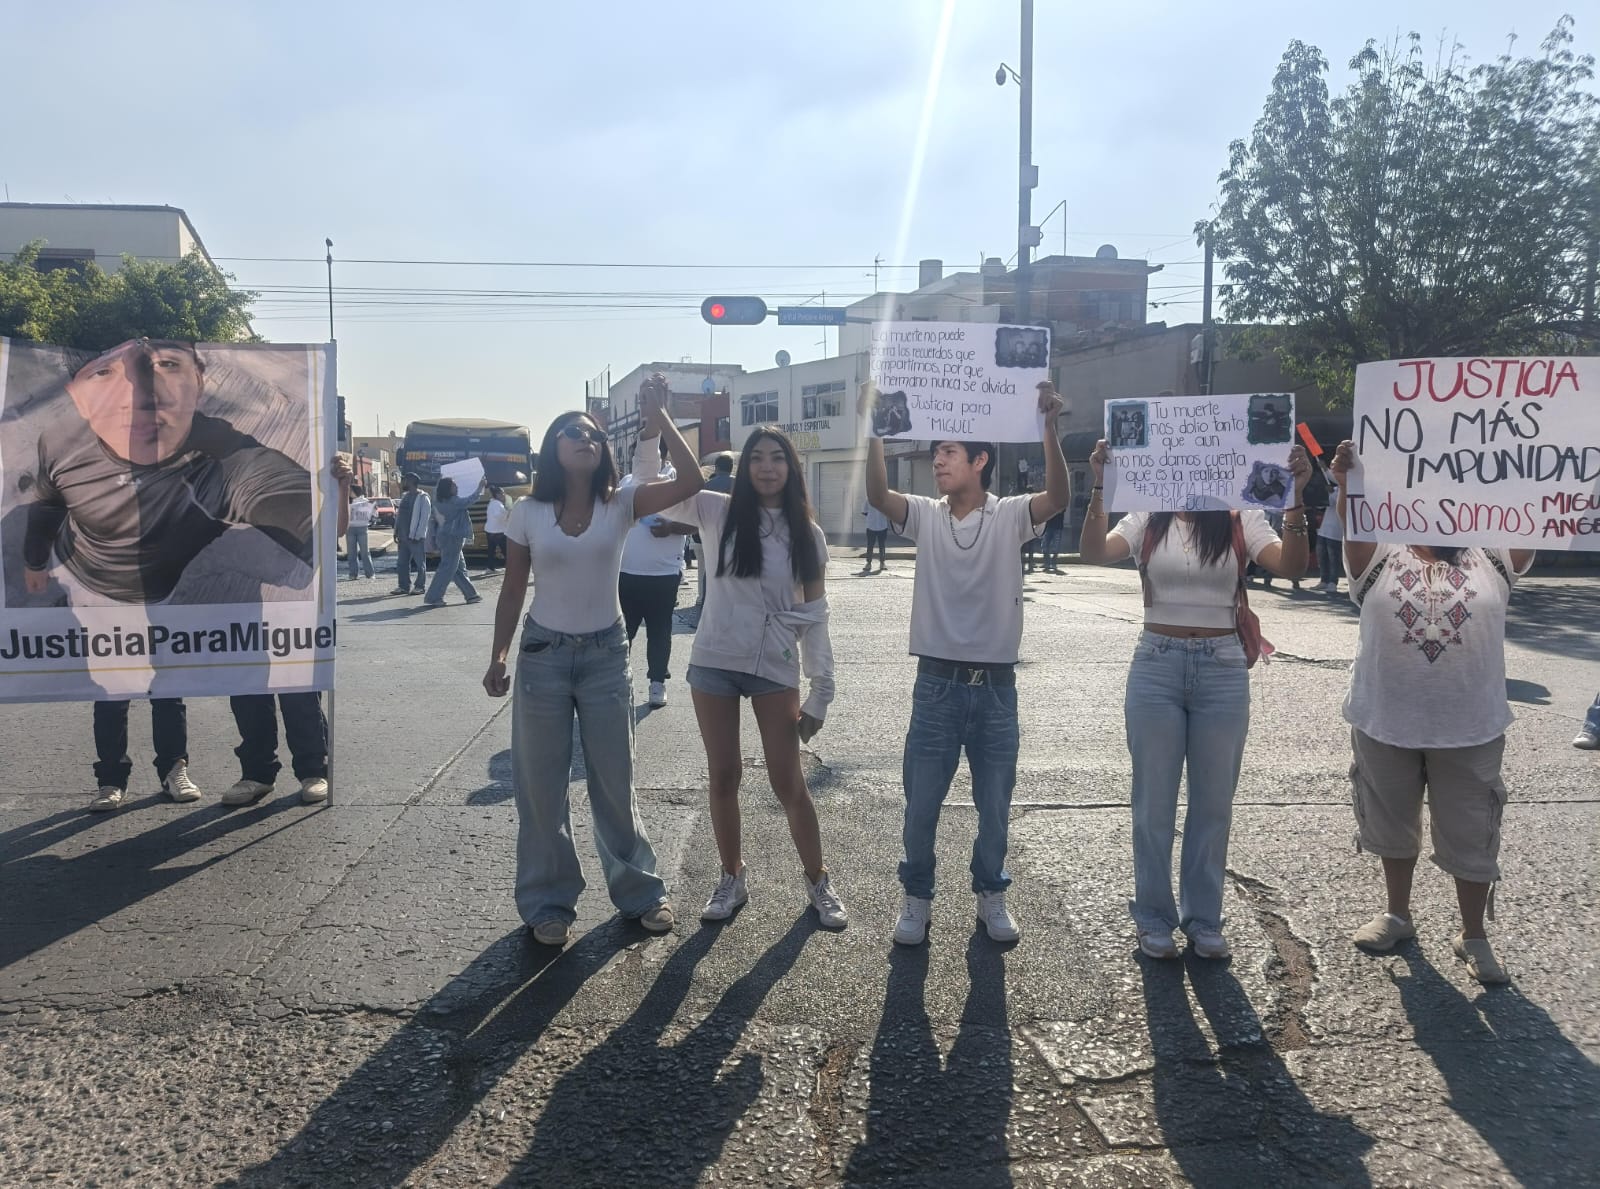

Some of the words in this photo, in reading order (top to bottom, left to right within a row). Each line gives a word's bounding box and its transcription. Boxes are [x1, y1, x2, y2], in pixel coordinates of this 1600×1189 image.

[890, 328, 923, 343] muerte
[924, 331, 935, 343] no
[938, 328, 965, 344] puede
[898, 343, 910, 357] los
[912, 345, 953, 360] recuerdos
[956, 350, 976, 363] que
[963, 365, 984, 379] que
[1393, 358, 1580, 402] JUSTICIA
[883, 372, 928, 388] hermano
[931, 376, 961, 390] nunca
[963, 380, 977, 392] se
[982, 377, 1016, 395] olvida
[910, 394, 954, 412] Justicia
[961, 402, 991, 417] para
[1151, 401, 1168, 419] Tu
[1174, 400, 1221, 418] muerte
[1150, 422, 1173, 436] nos
[1179, 419, 1209, 434] dolio
[1359, 408, 1424, 455] NO
[1450, 401, 1543, 445] MÁS
[1162, 436, 1185, 452] que
[1195, 435, 1220, 447] aun
[1114, 455, 1130, 468] no
[1133, 454, 1154, 467] nos
[1159, 451, 1201, 467] damos
[1205, 448, 1246, 467] cuenta
[1406, 443, 1600, 488] IMPUNIDAD
[1126, 470, 1151, 489] que
[1155, 469, 1168, 481] es
[1171, 467, 1183, 481] la
[1189, 466, 1235, 482] realidad
[1202, 481, 1234, 497] PARA
[1347, 492, 1428, 535] Todos
[1436, 498, 1536, 536] Somos
